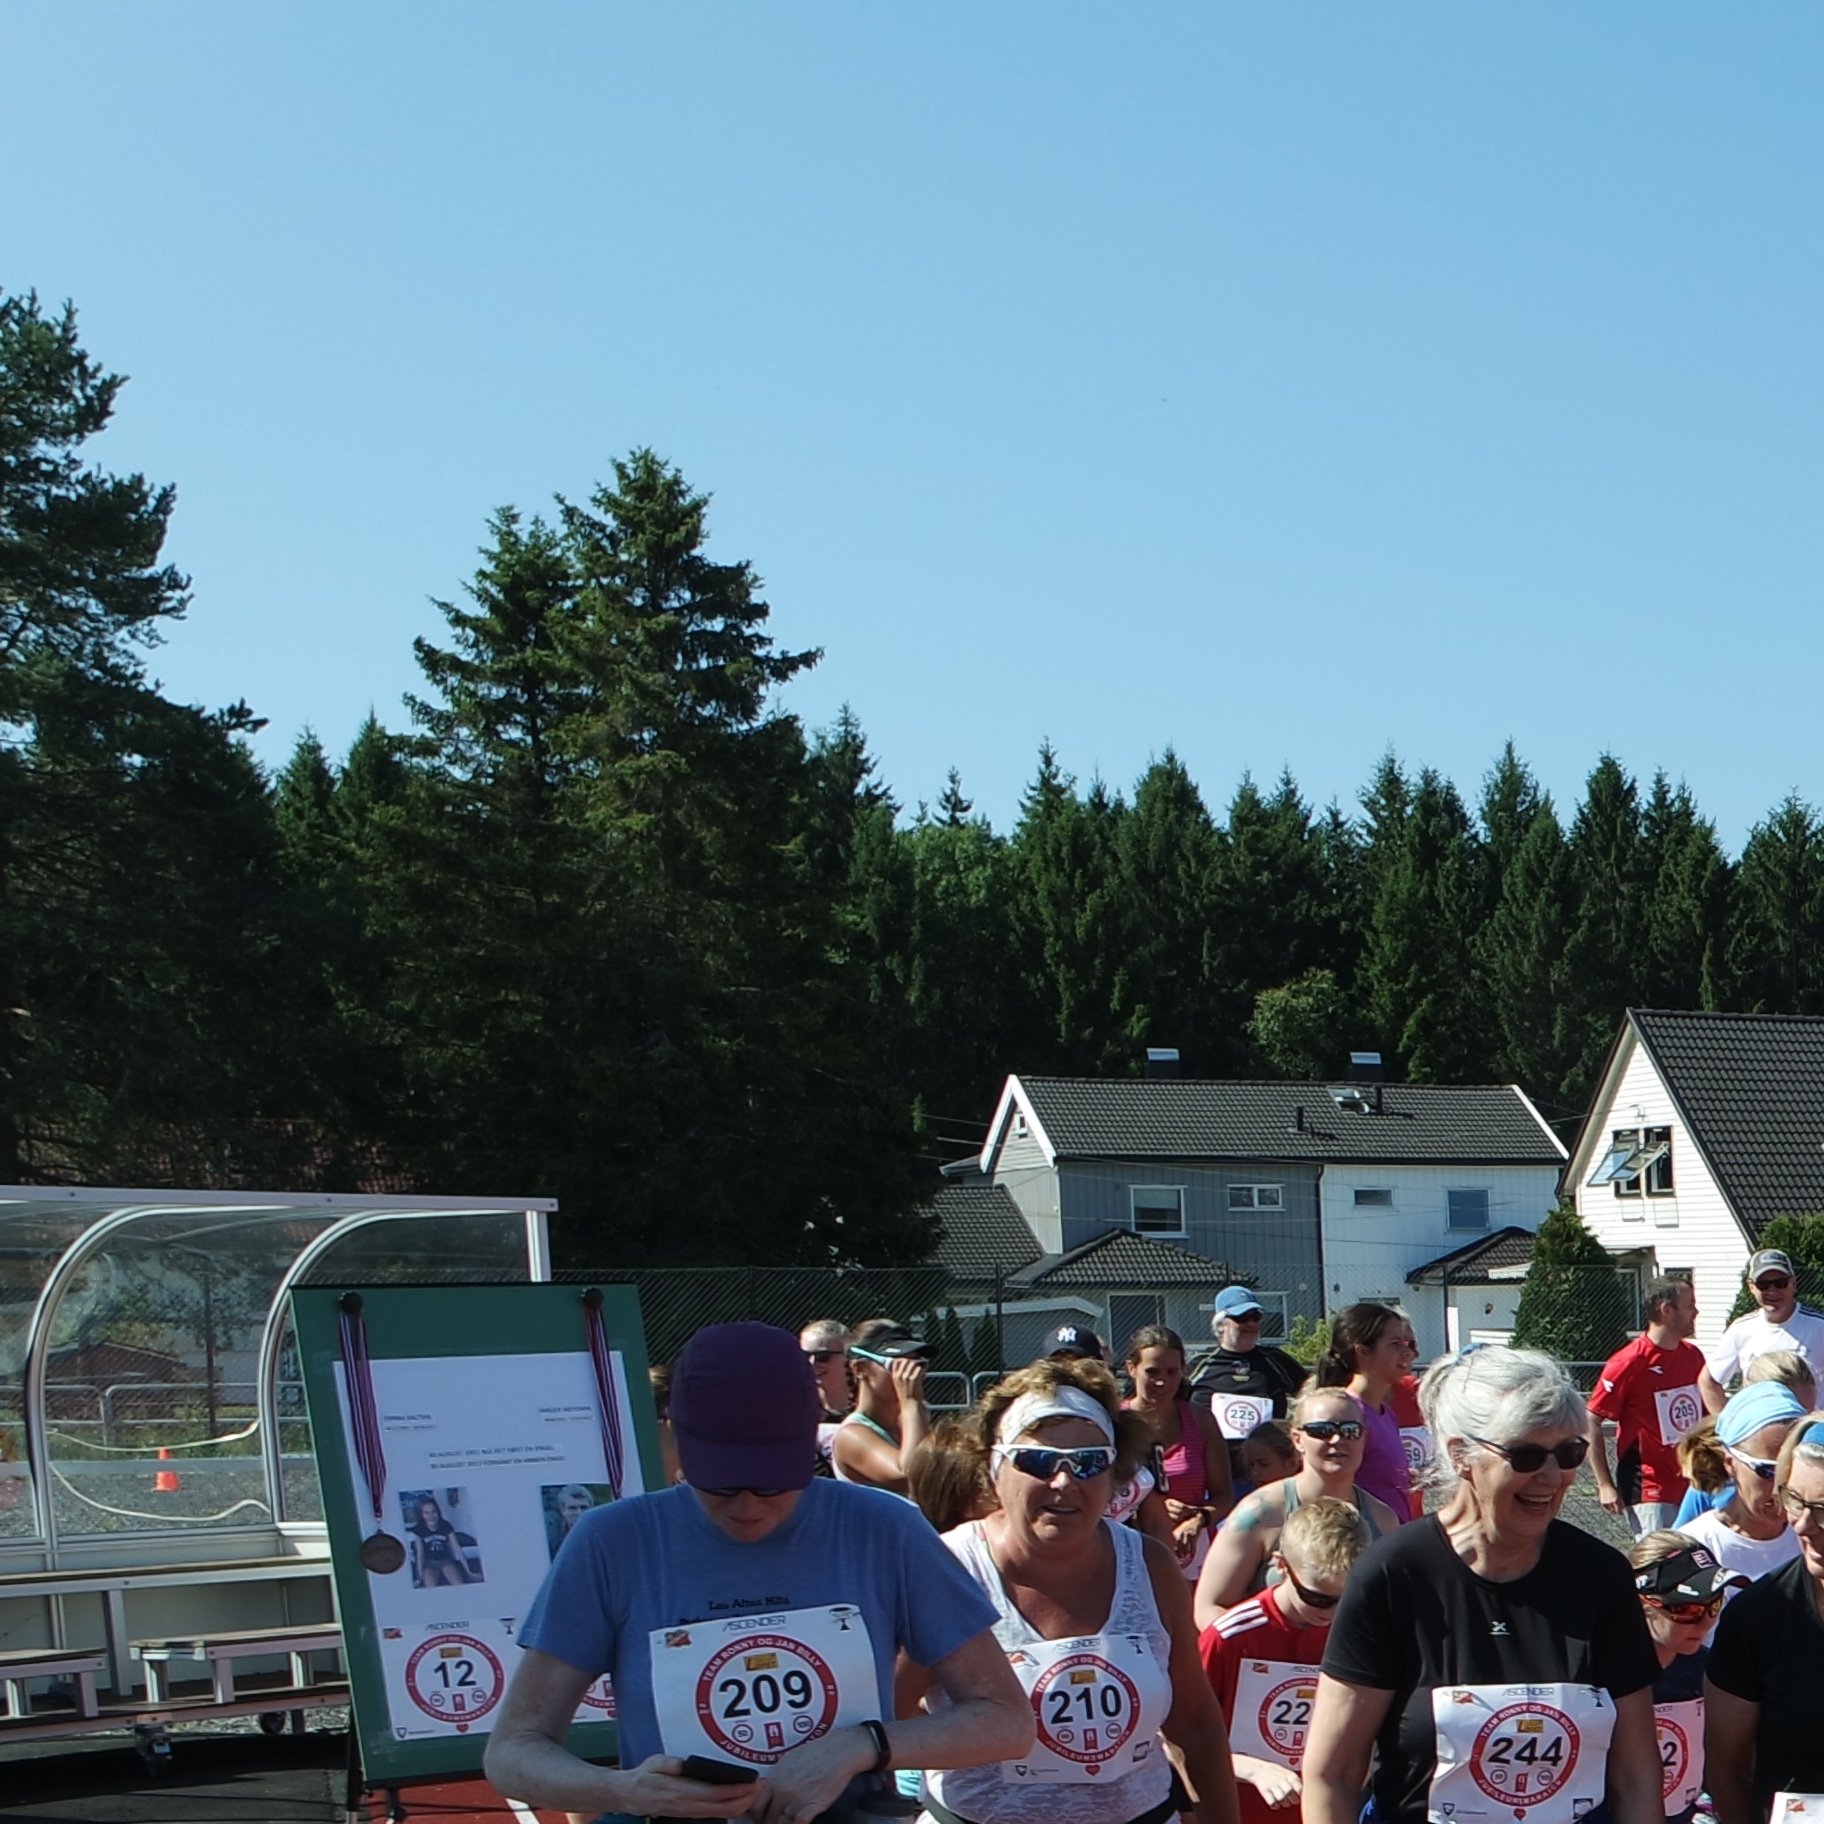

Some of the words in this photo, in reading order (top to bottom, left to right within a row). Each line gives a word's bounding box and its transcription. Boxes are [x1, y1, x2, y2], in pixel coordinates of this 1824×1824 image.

[1230, 1408, 1255, 1421] 225
[1674, 1404, 1694, 1419] 205
[722, 1615, 786, 1632] ASCENDER
[703, 1657, 724, 1682] TEAM
[723, 1639, 755, 1660] RONNY
[757, 1637, 774, 1646] OG
[775, 1638, 796, 1651] JAN
[796, 1646, 822, 1668] BILLY
[434, 1660, 477, 1688] 12
[1035, 1673, 1051, 1693] TEAM
[718, 1670, 813, 1719] 209
[1501, 1687, 1555, 1697] ASCENDER
[1048, 1685, 1122, 1725] 210
[1272, 1700, 1310, 1725] 22
[1480, 1717, 1498, 1737] TEAM
[1487, 1736, 1563, 1767] 244
